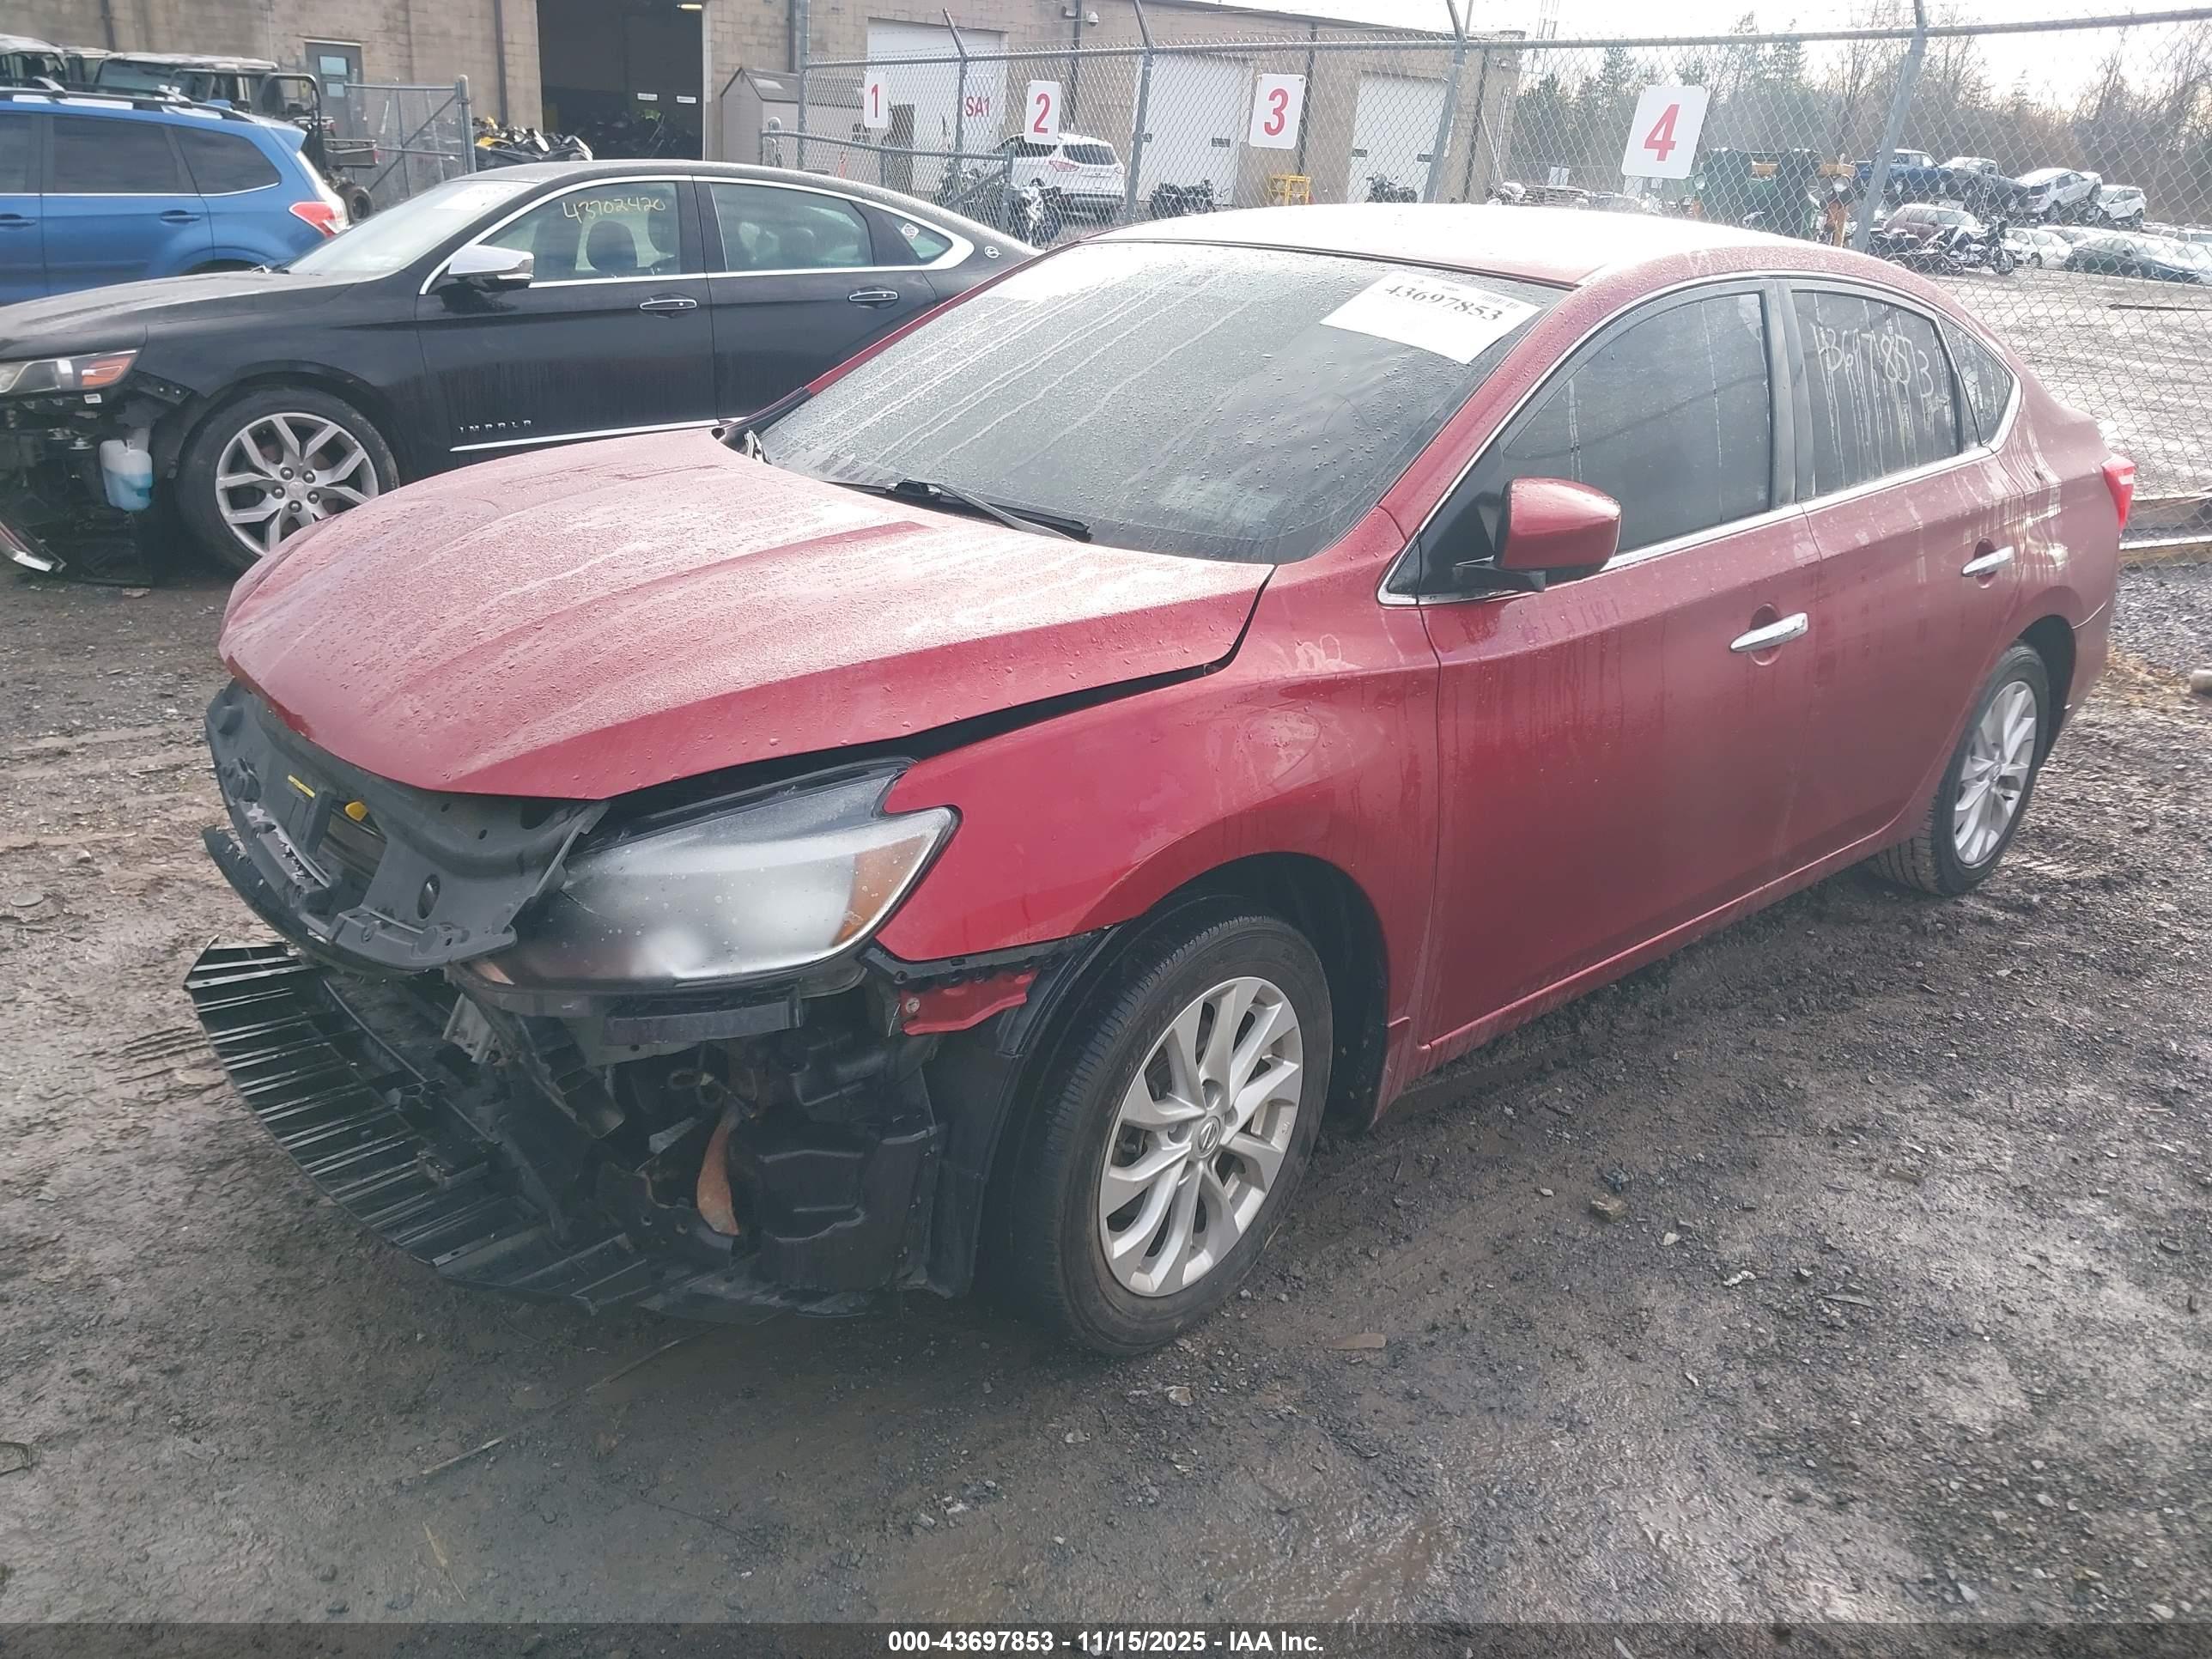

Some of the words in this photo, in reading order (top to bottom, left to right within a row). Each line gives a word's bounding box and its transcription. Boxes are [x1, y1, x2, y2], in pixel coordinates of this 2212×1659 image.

[871, 83, 879, 118] 1
[964, 95, 991, 118] SA1
[1033, 93, 1051, 134] 2
[1264, 88, 1289, 137] 3
[1644, 103, 1680, 162] 4
[562, 197, 666, 224] 43702420
[1384, 284, 1504, 322] 43697853
